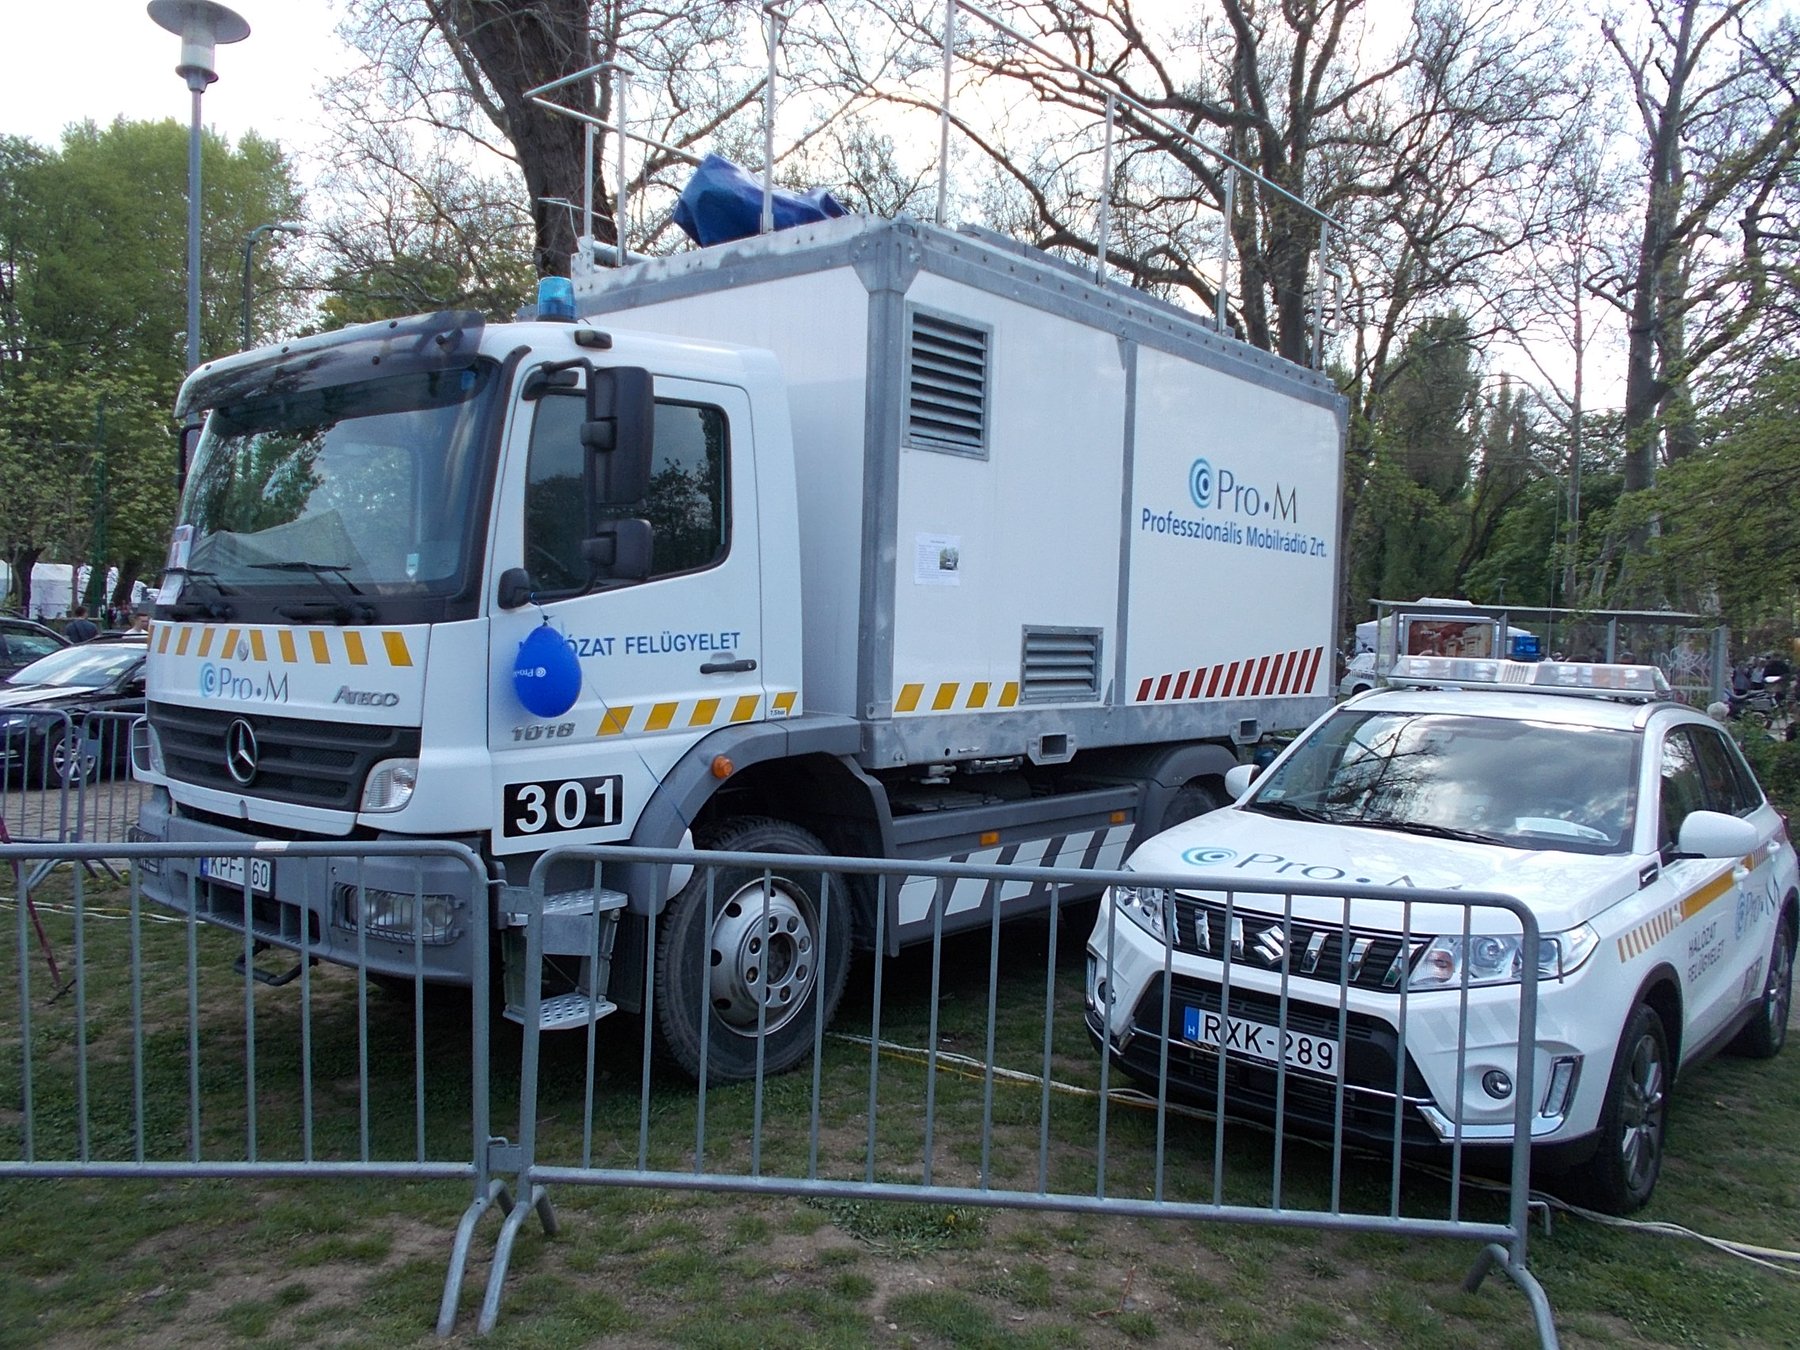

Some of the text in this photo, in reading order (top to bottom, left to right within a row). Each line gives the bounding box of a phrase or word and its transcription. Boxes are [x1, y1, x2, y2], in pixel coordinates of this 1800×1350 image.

[1142, 507, 1327, 557] Professzionális Mobilrádió Zrt.
[625, 631, 741, 655] FELÜGYELET
[516, 778, 614, 833] 301
[210, 857, 269, 888] KPF-60
[1204, 1014, 1333, 1070] RXK-289
